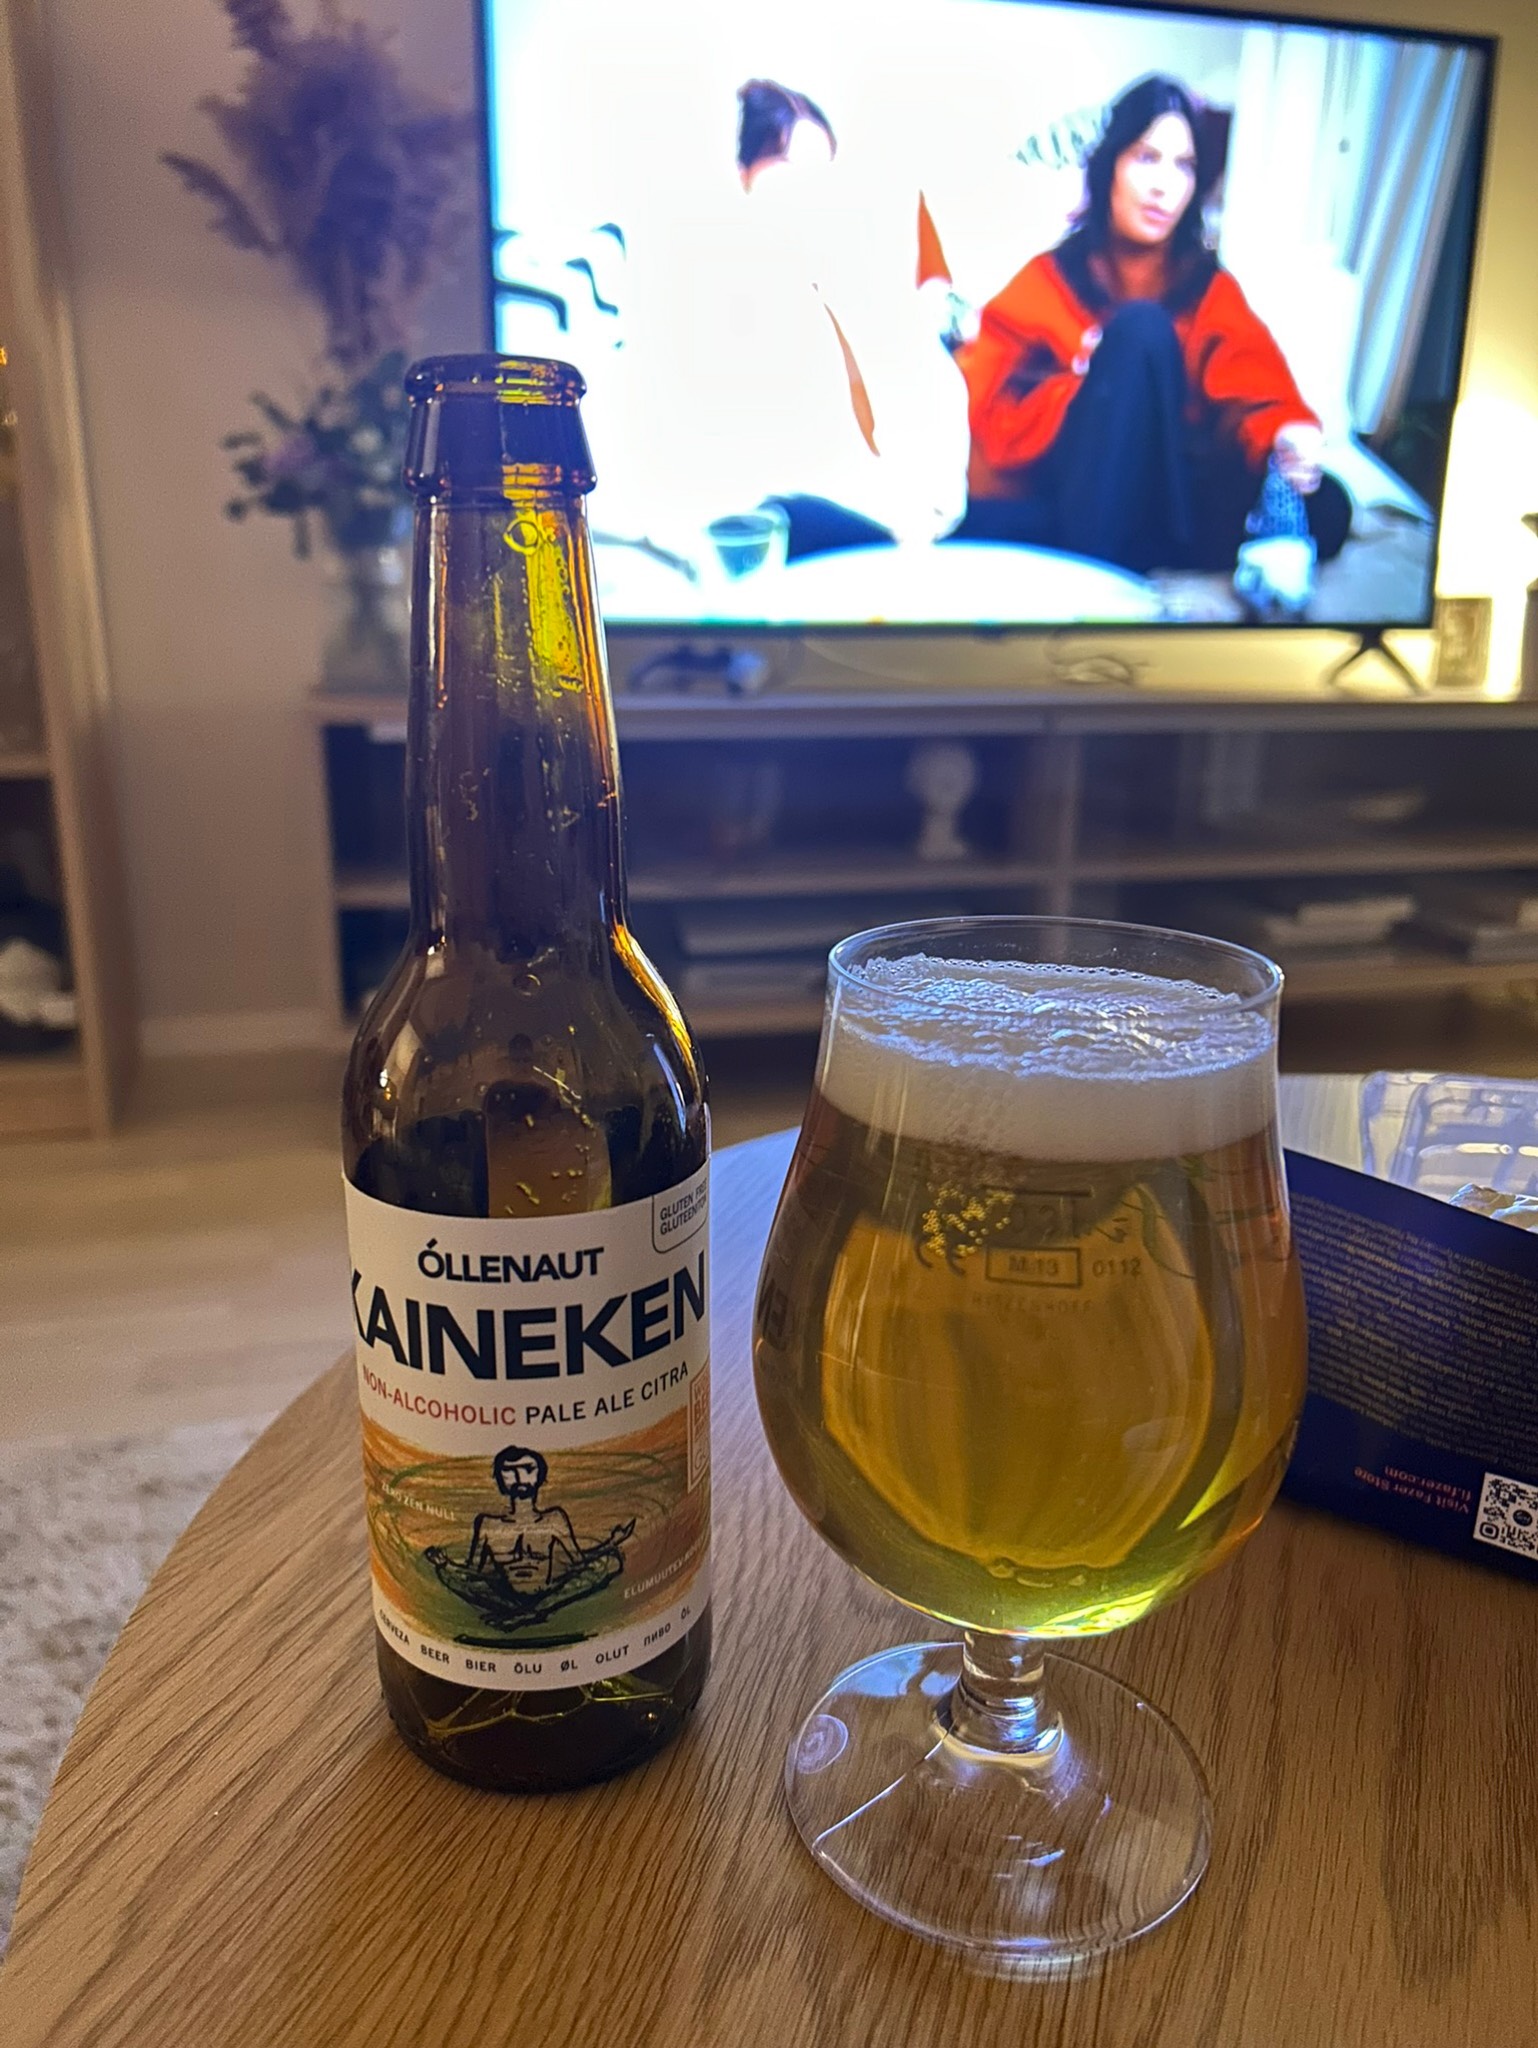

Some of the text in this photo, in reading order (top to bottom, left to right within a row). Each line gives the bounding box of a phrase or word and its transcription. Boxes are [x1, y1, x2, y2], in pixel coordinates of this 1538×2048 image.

[660, 1192, 694, 1221] GLUTEN
[1092, 1256, 1141, 1278] 0112
[363, 1360, 689, 1425] NON-ALCOHOLIC PALE ALE CITRA
[1354, 1466, 1470, 1514] Visit Fazer Store
[1385, 1465, 1471, 1501] fi.fazer.com
[404, 1494, 423, 1512] ZEN
[426, 1503, 457, 1521] NULL
[380, 1609, 410, 1645] CERVEZA
[420, 1644, 450, 1664] BEER
[465, 1659, 496, 1673] BIER
[560, 1660, 578, 1672] ØL
[595, 1645, 630, 1664] OLUT
